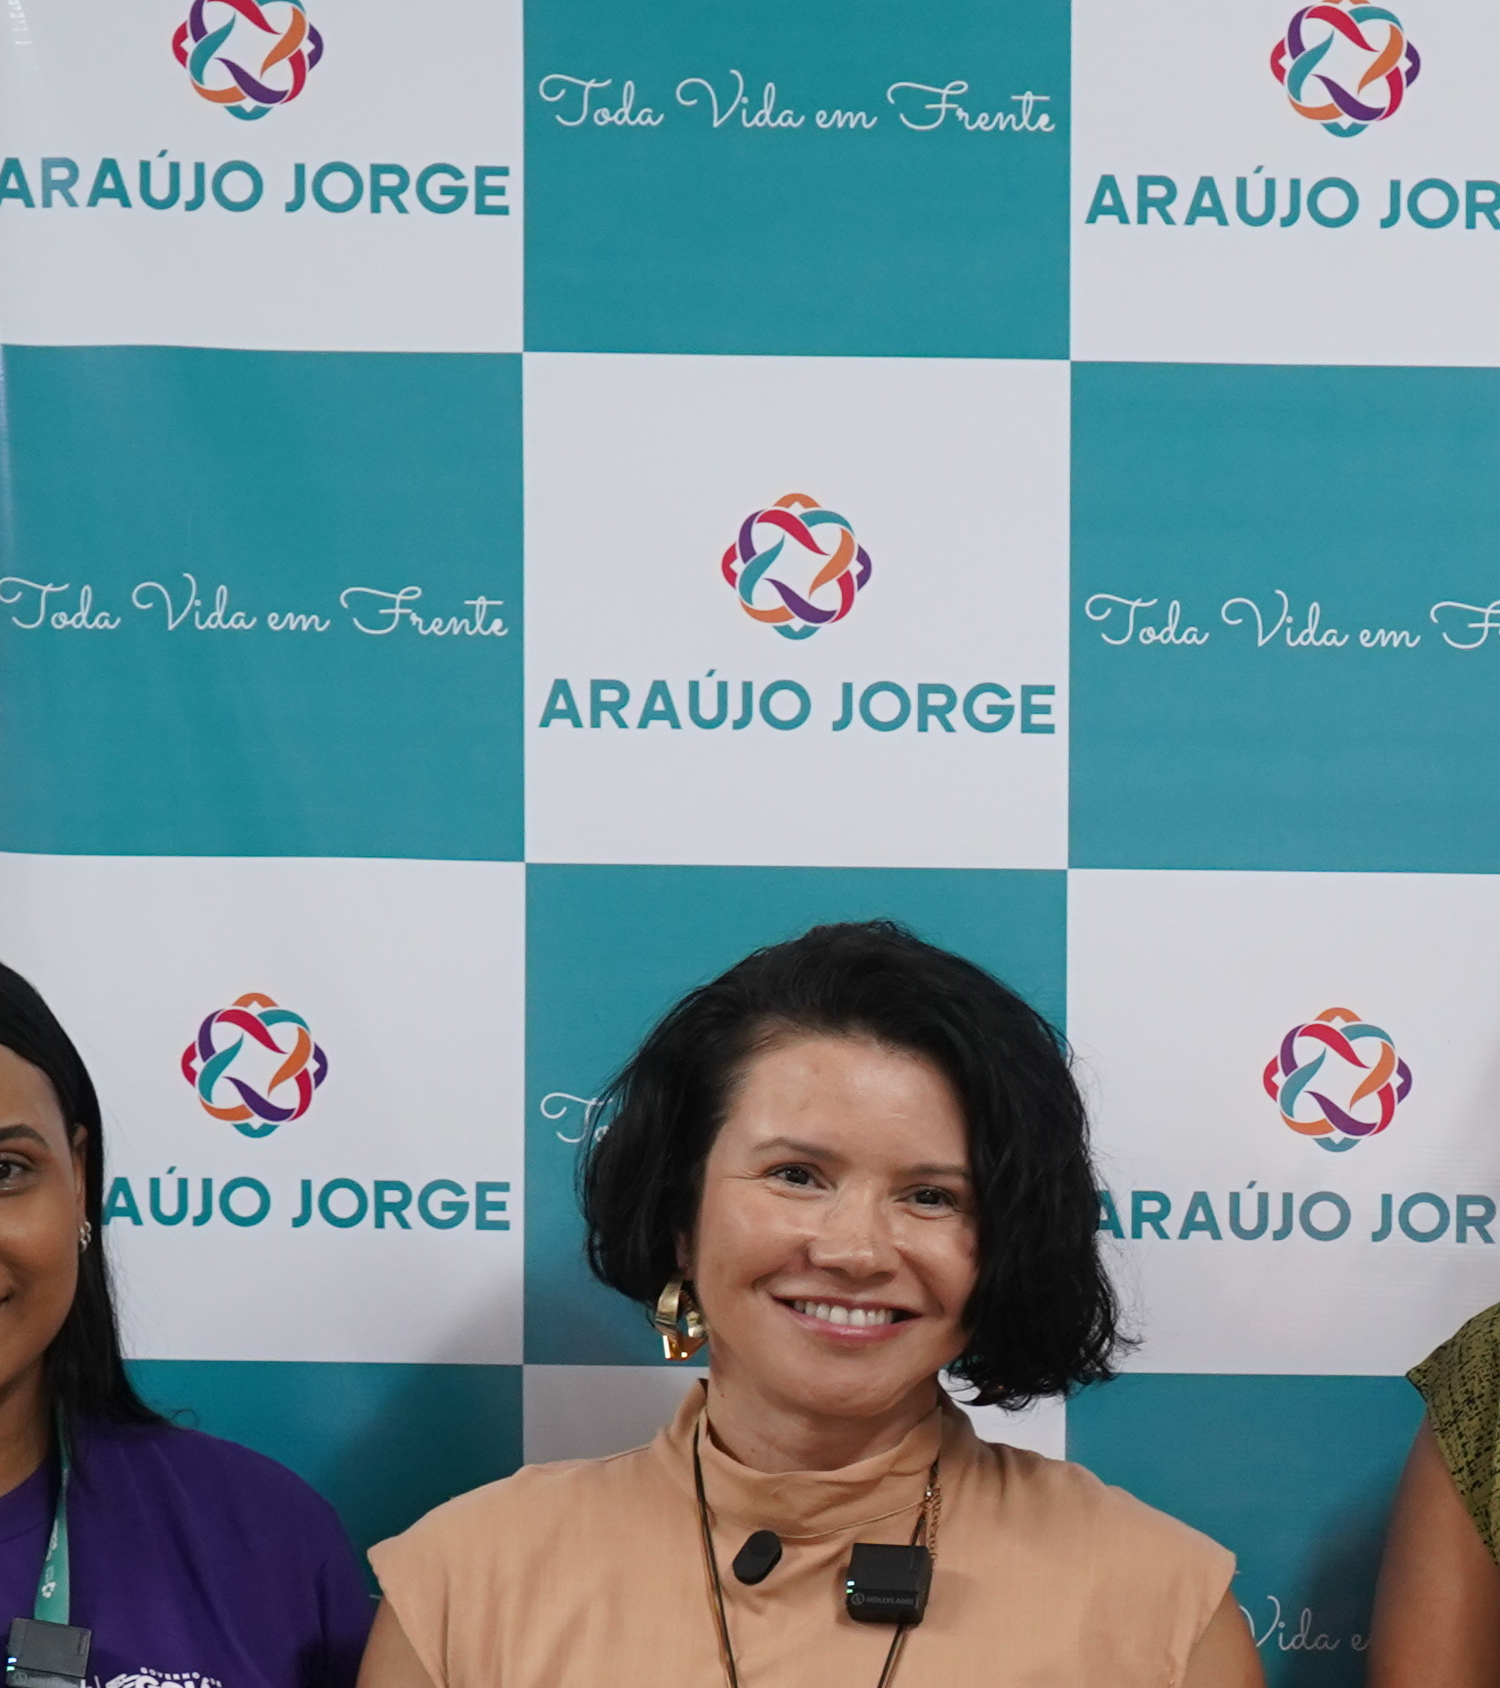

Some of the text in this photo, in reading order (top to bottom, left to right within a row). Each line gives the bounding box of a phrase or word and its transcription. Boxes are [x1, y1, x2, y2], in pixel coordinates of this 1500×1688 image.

[539, 70, 1055, 132] Toda Vida em Frente
[286, 163, 510, 215] JORGE
[1086, 168, 1359, 228] ARAÚJO
[132, 573, 257, 630] Vida
[268, 613, 330, 631] em
[340, 586, 508, 636] Frente
[1085, 594, 1209, 645] Toda
[1221, 590, 1349, 647] Vida
[1360, 629, 1420, 647] em
[539, 671, 1056, 734] ARAÚJO JORGE
[102, 1166, 509, 1230] AÚJO JORGE
